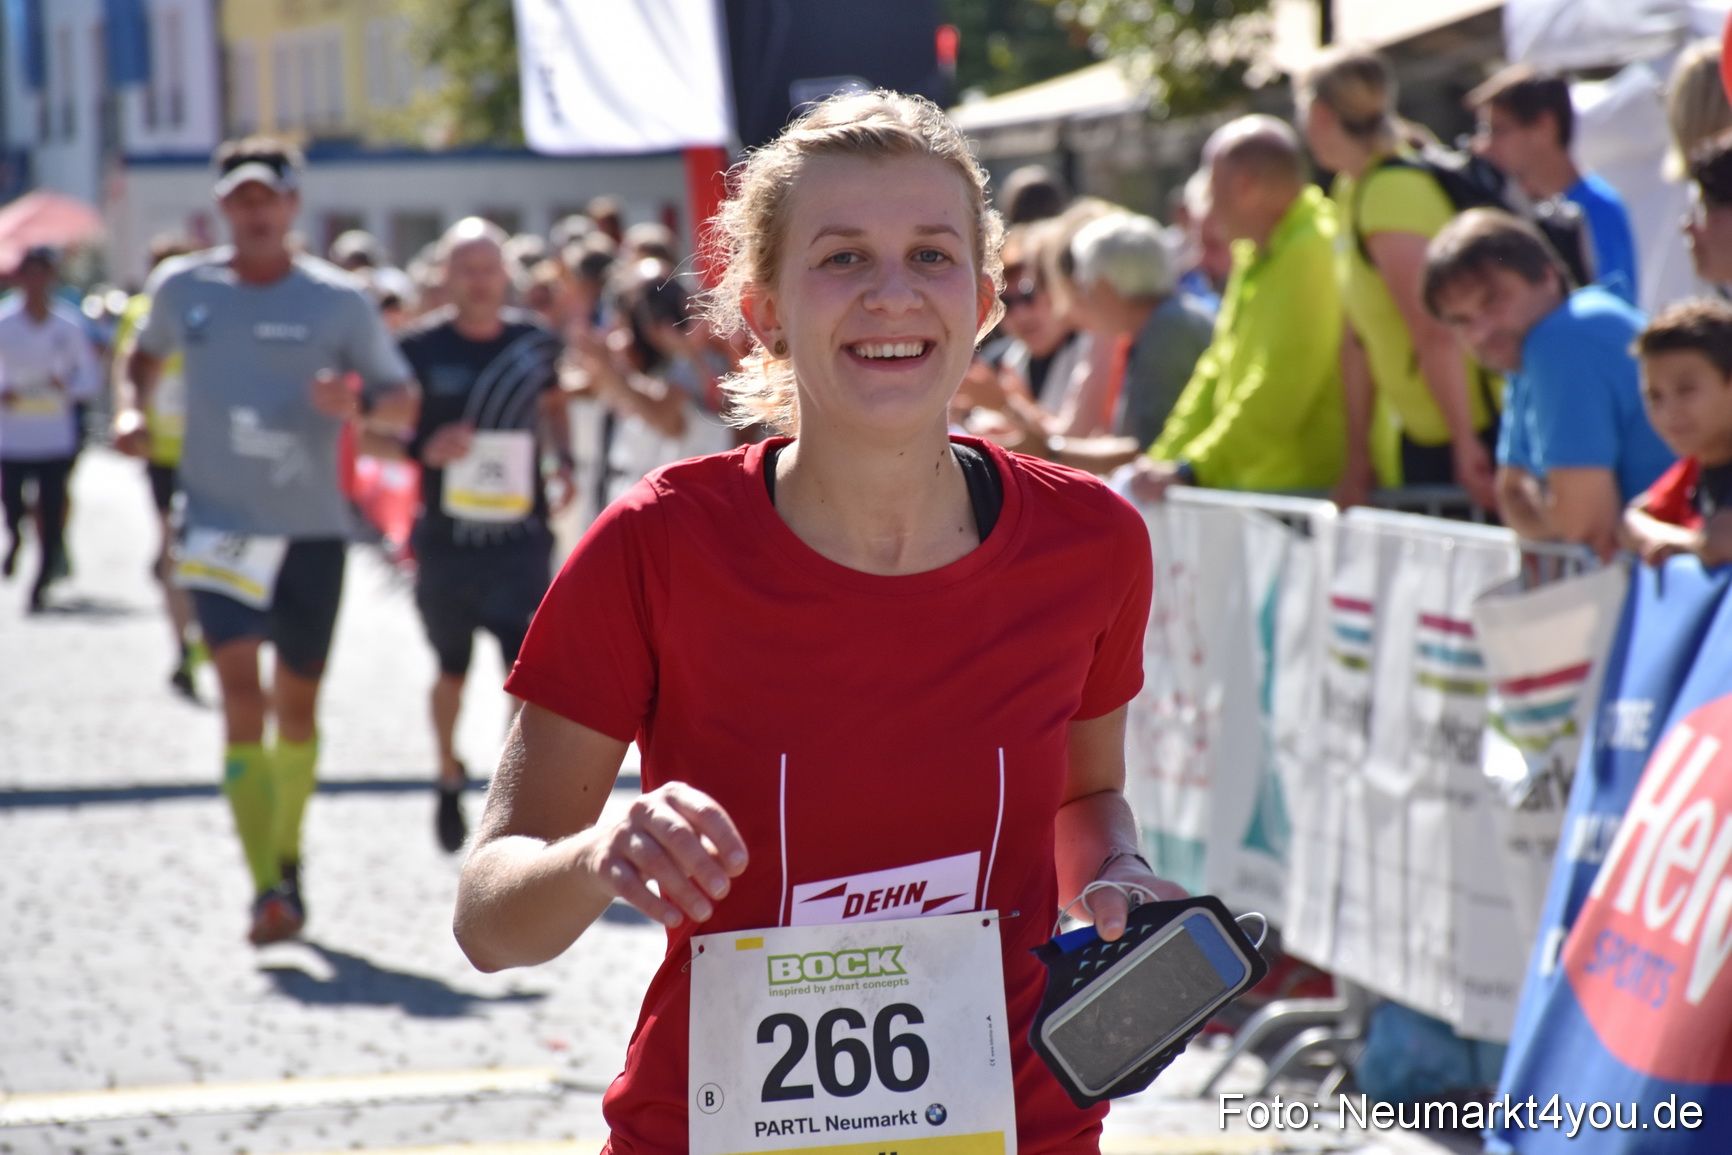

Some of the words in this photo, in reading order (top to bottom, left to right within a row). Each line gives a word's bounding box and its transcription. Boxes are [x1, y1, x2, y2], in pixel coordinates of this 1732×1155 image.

[842, 880, 928, 919] DEHN
[767, 945, 908, 985] BOCK
[769, 986, 811, 998] inspired
[813, 983, 826, 994] by
[829, 981, 860, 992] smart
[863, 977, 909, 990] concepts
[756, 1002, 931, 1103] 266
[705, 1090, 716, 1108] B
[754, 1117, 821, 1138] PARTL
[825, 1108, 918, 1132] Neumarkt
